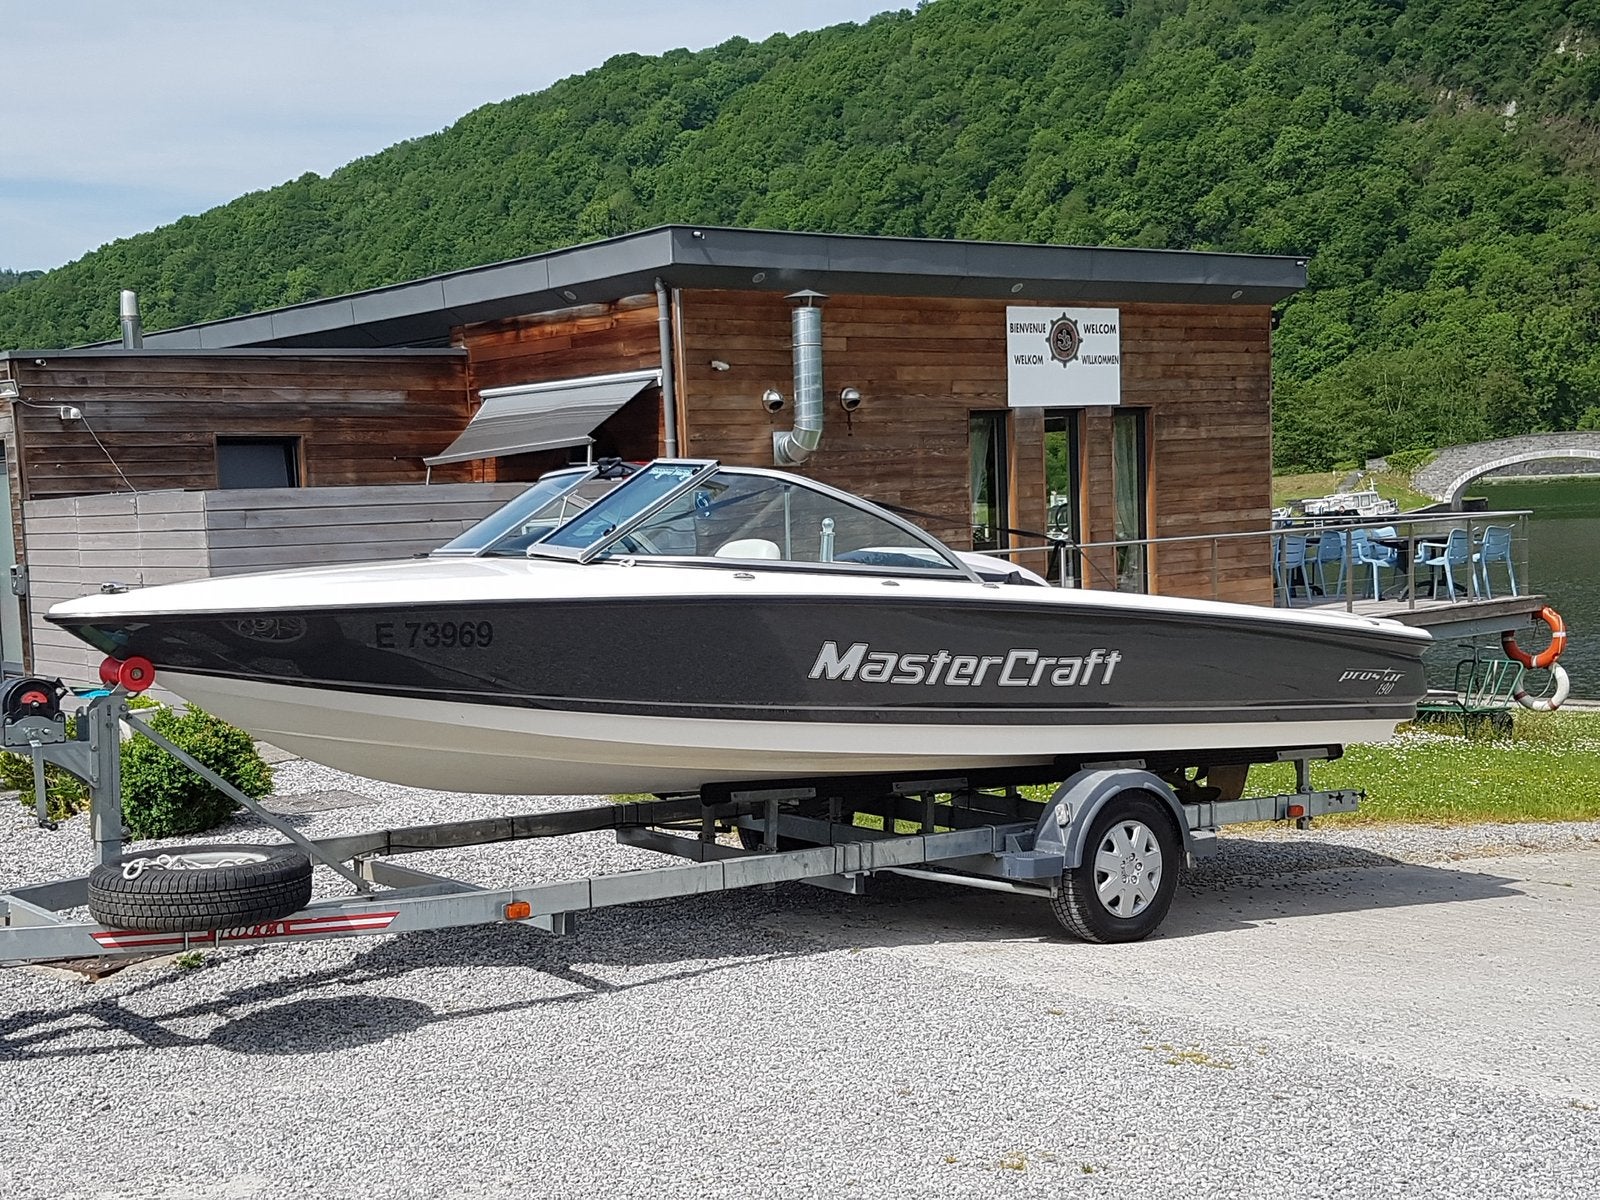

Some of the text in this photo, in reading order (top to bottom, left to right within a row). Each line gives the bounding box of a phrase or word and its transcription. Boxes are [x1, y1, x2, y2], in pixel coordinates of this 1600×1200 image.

[1009, 323, 1046, 334] BIENVENUE
[1083, 323, 1117, 334] WELCOM
[1014, 355, 1044, 365] WELKOM
[1081, 355, 1119, 365] WILLKOMMEN
[375, 620, 494, 649] E 73969
[807, 640, 1122, 687] MasterCraft
[1375, 682, 1395, 695] 190
